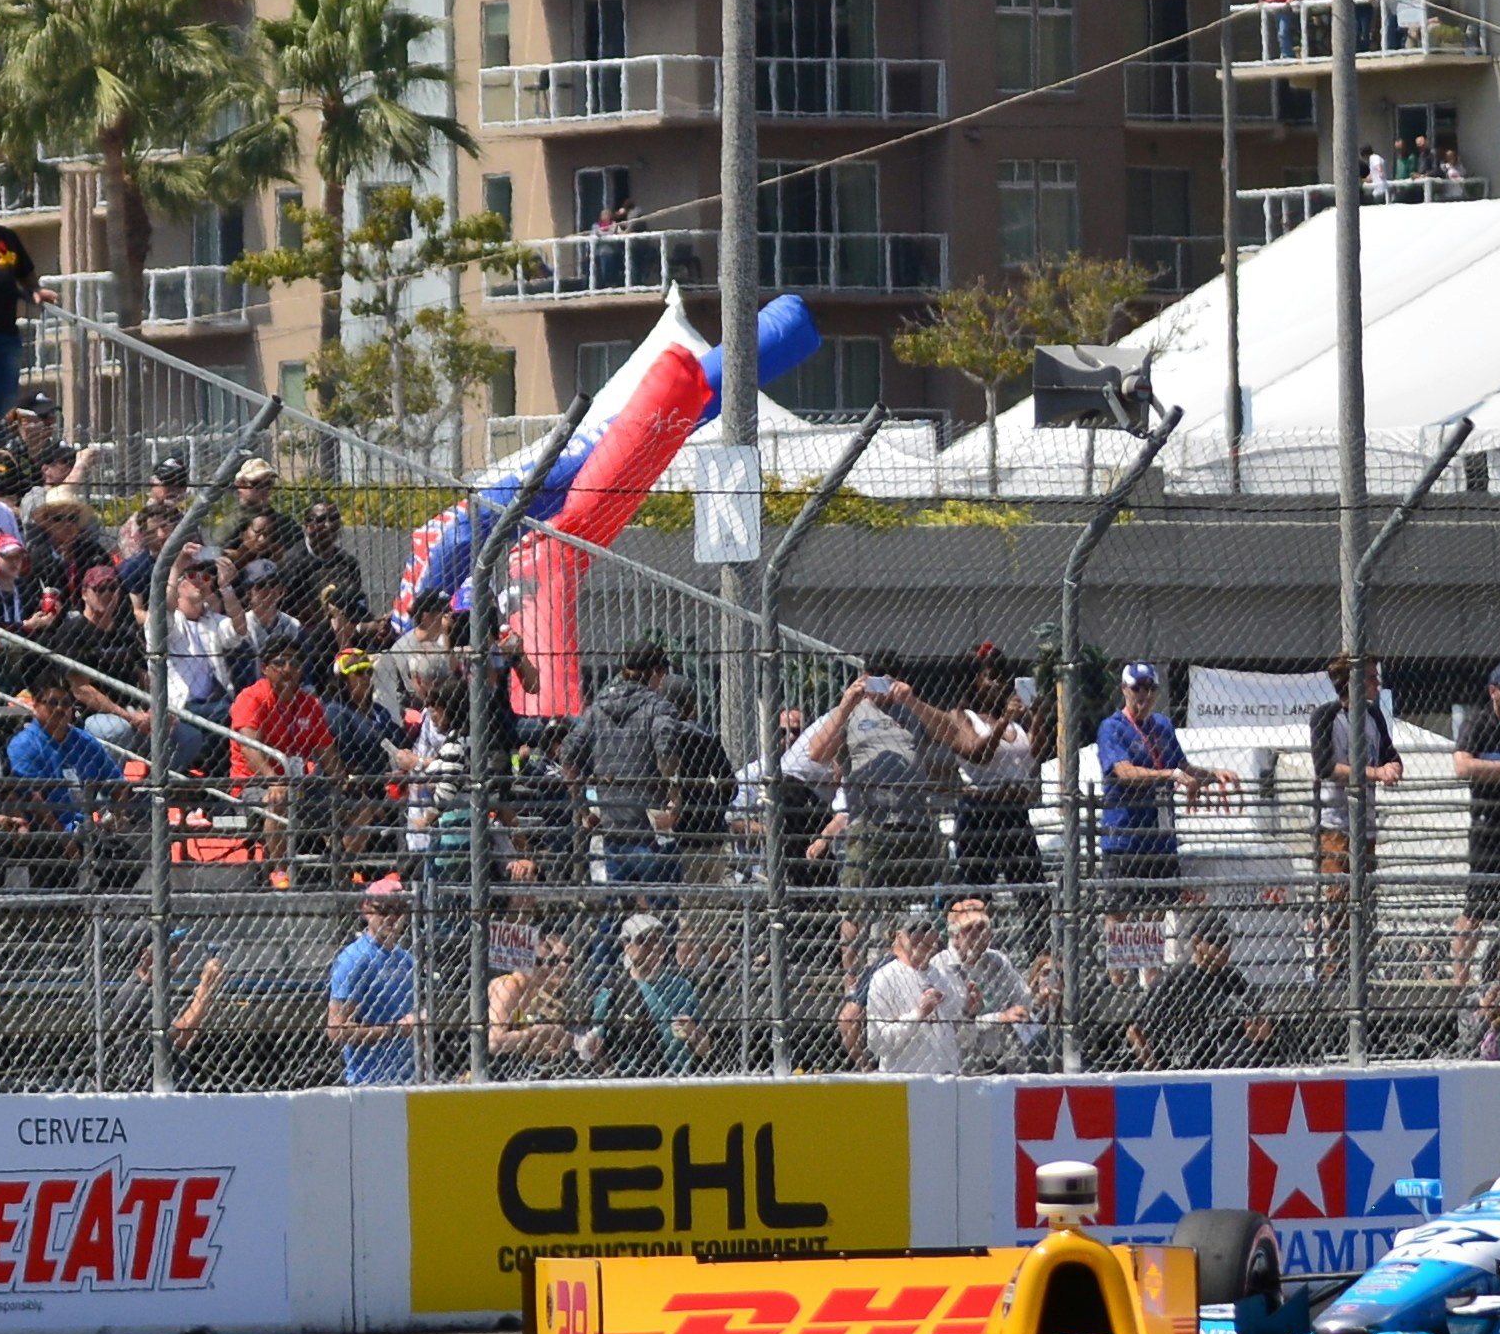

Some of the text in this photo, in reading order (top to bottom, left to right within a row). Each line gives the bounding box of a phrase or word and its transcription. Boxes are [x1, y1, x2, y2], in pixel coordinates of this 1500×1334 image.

[1197, 703, 1237, 716] SAM'S
[1242, 705, 1279, 716] AUTO
[18, 1117, 128, 1147] CERVEZA
[497, 1122, 829, 1235] GEHL
